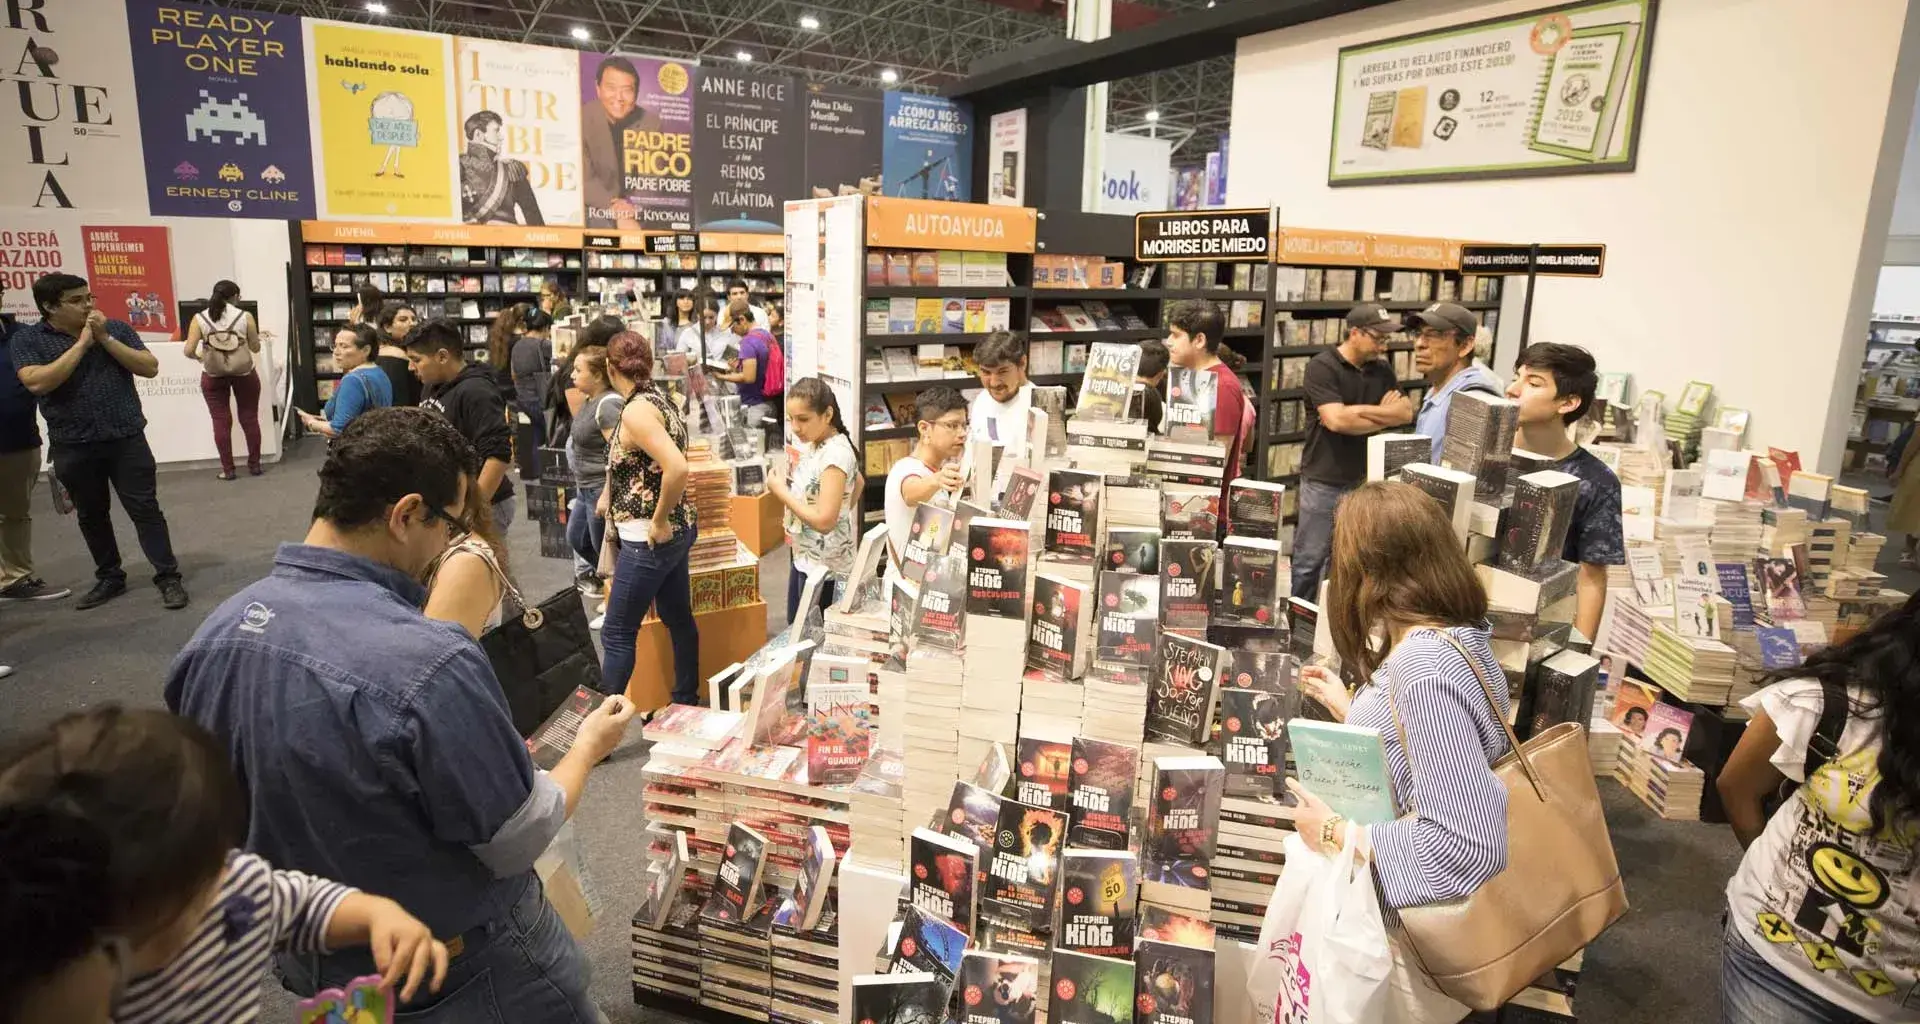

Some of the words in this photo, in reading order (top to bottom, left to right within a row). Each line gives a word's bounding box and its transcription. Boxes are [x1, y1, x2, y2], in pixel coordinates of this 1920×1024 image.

[158, 8, 274, 35] READY
[152, 29, 284, 58] PLAYER
[1400, 57, 1411, 69] TU
[1412, 50, 1452, 66] RELAJITO
[1454, 41, 1512, 59] FINANCIERO
[185, 54, 258, 76] ONE
[324, 54, 396, 73] hablando
[400, 64, 429, 76] sola
[1360, 77, 1371, 87] NO
[1372, 70, 1404, 86] SUFRAS
[1405, 67, 1424, 79] POR
[1425, 62, 1459, 77] DINERO
[1460, 58, 1483, 73] ESTE
[701, 75, 746, 97] ANNE
[751, 79, 785, 101] RICE
[1479, 91, 1494, 103] 12
[810, 99, 830, 112] Alma
[832, 101, 853, 113] Delia
[898, 103, 936, 119] ¿CÓMO
[938, 109, 960, 122] NOS
[706, 113, 721, 129] EL
[724, 114, 779, 134] PRÍNCIPE
[810, 109, 840, 122] Murillo
[1555, 109, 1584, 122] 2019
[73, 127, 87, 136] 50
[889, 116, 968, 135] ARREGLAMOS?
[623, 129, 691, 152] PADRE
[722, 134, 764, 151] LESTAT
[623, 150, 692, 177] RICO
[720, 163, 765, 181] REINOS
[624, 177, 657, 192] PADRE
[658, 178, 691, 193] POBRE
[166, 186, 241, 199] ERNEST
[246, 189, 299, 201] CLINE
[711, 189, 775, 208] ATLÁNTIDA
[588, 207, 631, 220] ROBERT
[643, 209, 690, 222] KIYOSAKI
[334, 226, 376, 238] JUVENIL
[905, 212, 1005, 239] AUTOAYUDA
[1159, 220, 1210, 236] LIBROS
[1212, 218, 1250, 234] PARA
[17, 230, 59, 247] SERÁ
[90, 230, 119, 242] ANDRÉS
[91, 242, 145, 253] OPPENHEIMER
[1143, 238, 1201, 255] MORIRSE
[1202, 238, 1220, 254] DE
[1221, 236, 1267, 253] MIEDO
[1464, 255, 1492, 265] NOVELA
[1493, 253, 1530, 265] HISTÓRICA
[1536, 255, 1562, 265] NOVELA
[1563, 253, 1600, 266] HISTÓRICA
[94, 265, 118, 275] QUIEN
[1092, 354, 1131, 373] KING
[161, 377, 201, 386] House
[1053, 508, 1080, 518] STEPHEN
[975, 567, 1000, 575] STEPHEN
[1164, 642, 1213, 669] STEPHEN
[1165, 659, 1203, 691] KING
[1157, 679, 1204, 711] DOCTOR
[1157, 699, 1201, 730] SUEÑO
[1232, 736, 1265, 746] STEPHEN
[817, 745, 831, 754] FIN
[832, 745, 844, 754] DE
[827, 756, 863, 766] GUARDIA
[1025, 781, 1050, 791] STEPHEN
[1080, 784, 1108, 795] STEPHEN
[998, 851, 1027, 866] STEPHEN
[919, 882, 951, 900] STEPHEN
[1105, 883, 1121, 898] 50
[1073, 915, 1109, 925] STEPHEN
[1160, 1013, 1194, 1024] STEPHEN
